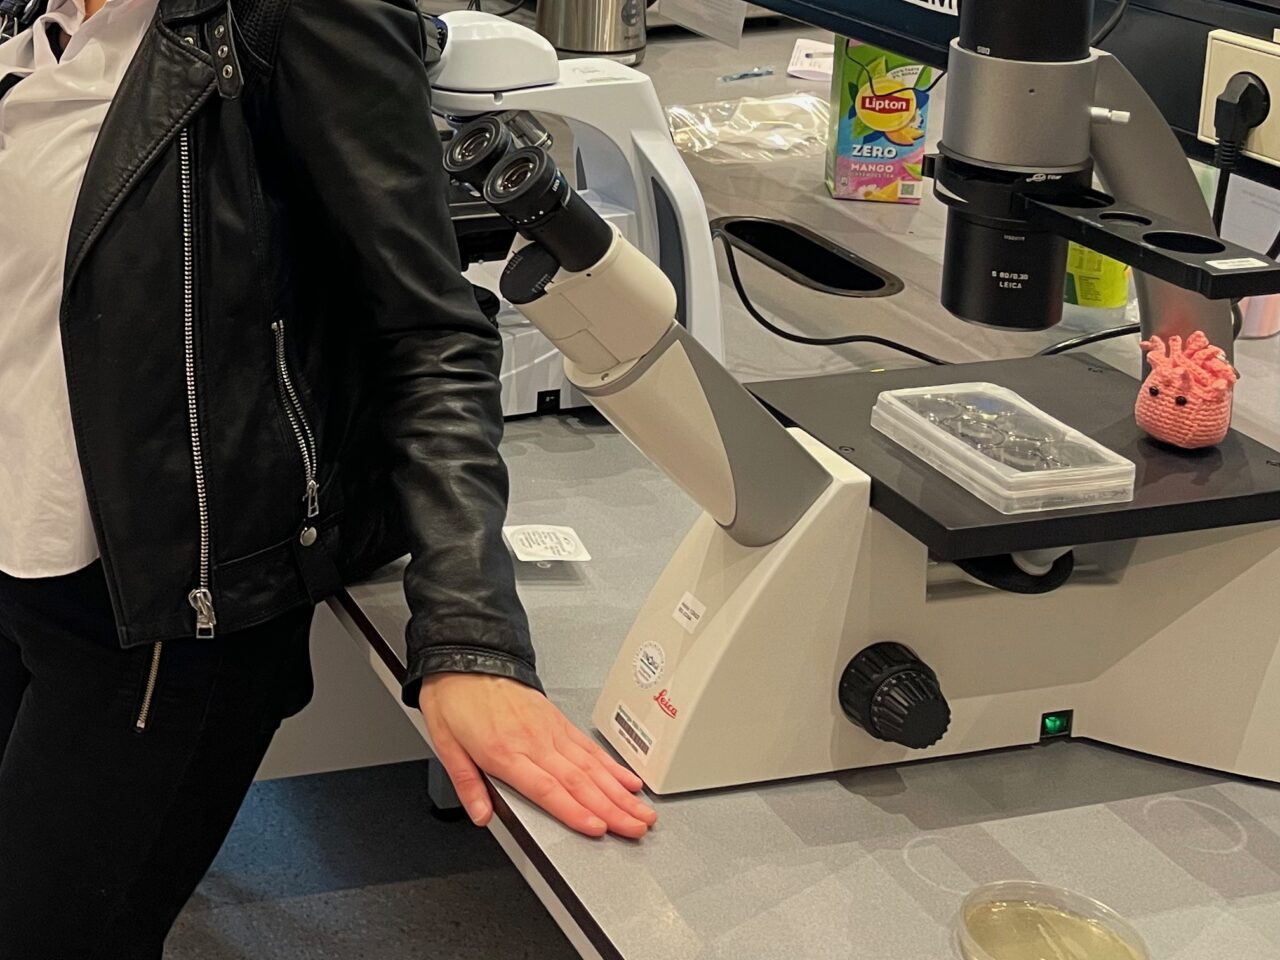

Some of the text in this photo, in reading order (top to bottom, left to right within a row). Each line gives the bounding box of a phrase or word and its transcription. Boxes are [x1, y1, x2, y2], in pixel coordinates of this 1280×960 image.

[865, 97, 907, 111] Lipton
[851, 144, 897, 159] ZERO
[850, 163, 894, 173] MANGO
[999, 281, 1022, 289] LEICA
[653, 689, 678, 719] Leica
